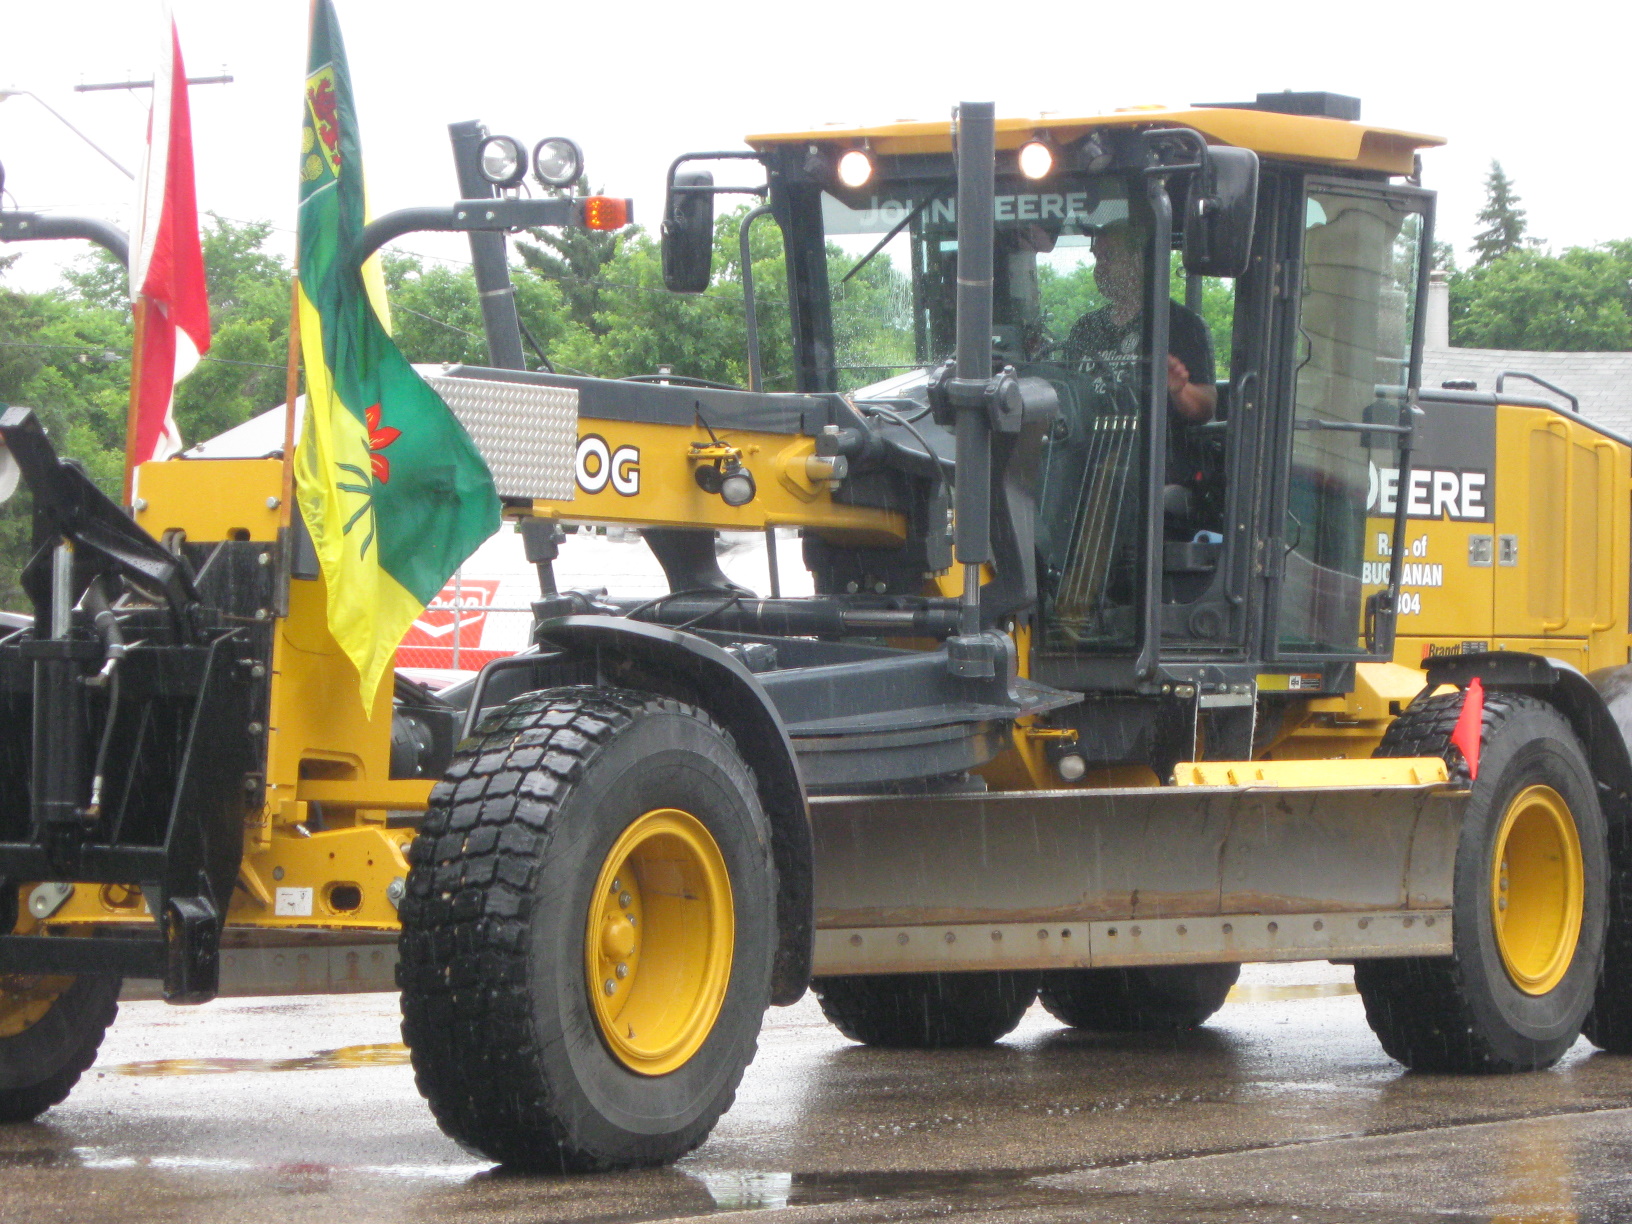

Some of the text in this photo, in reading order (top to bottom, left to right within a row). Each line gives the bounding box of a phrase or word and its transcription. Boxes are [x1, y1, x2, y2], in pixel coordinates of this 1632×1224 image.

[994, 192, 1088, 222] EERE
[1412, 535, 1428, 557] of
[1362, 562, 1443, 586] BUCANAN
